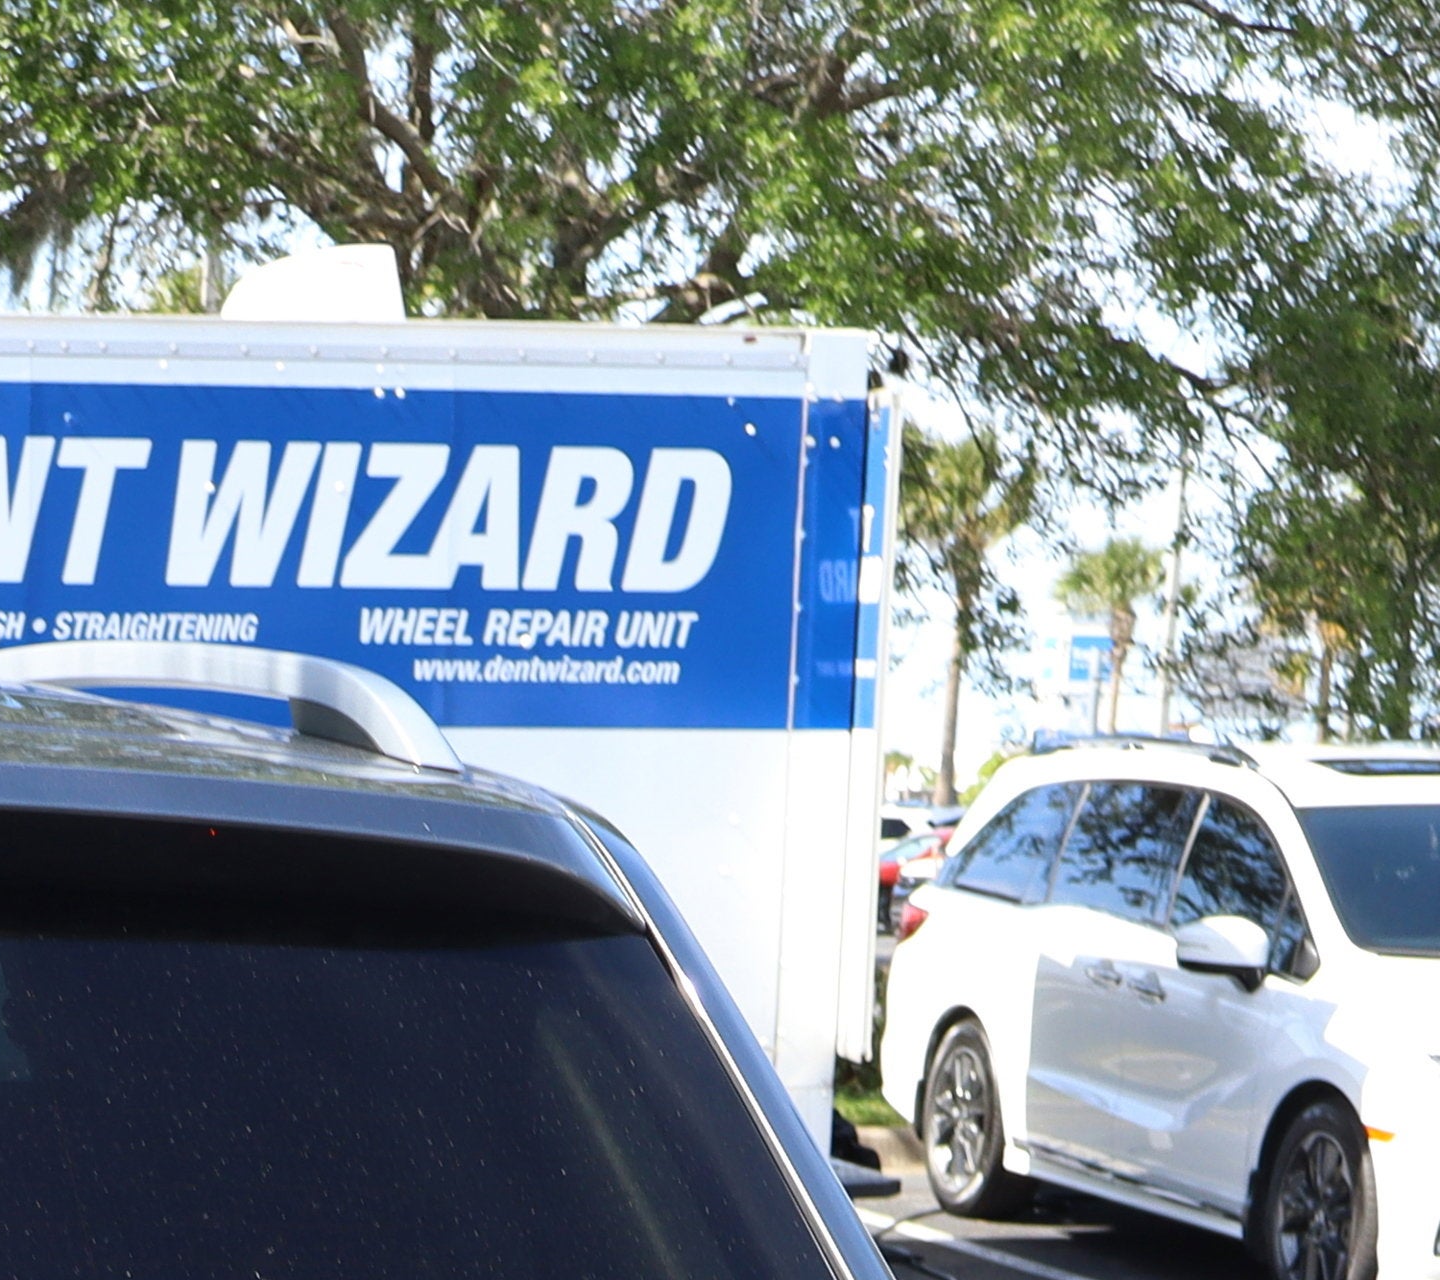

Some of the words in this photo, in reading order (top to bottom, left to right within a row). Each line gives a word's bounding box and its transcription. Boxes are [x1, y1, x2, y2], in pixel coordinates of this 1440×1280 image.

[165, 438, 733, 594] WIZARD
[53, 612, 259, 643] STRAIGHTENING
[359, 607, 474, 646] WHEEL
[482, 608, 610, 649] REPAIR
[614, 610, 700, 649] UNIT
[413, 655, 681, 685] www.dentwizard.com
